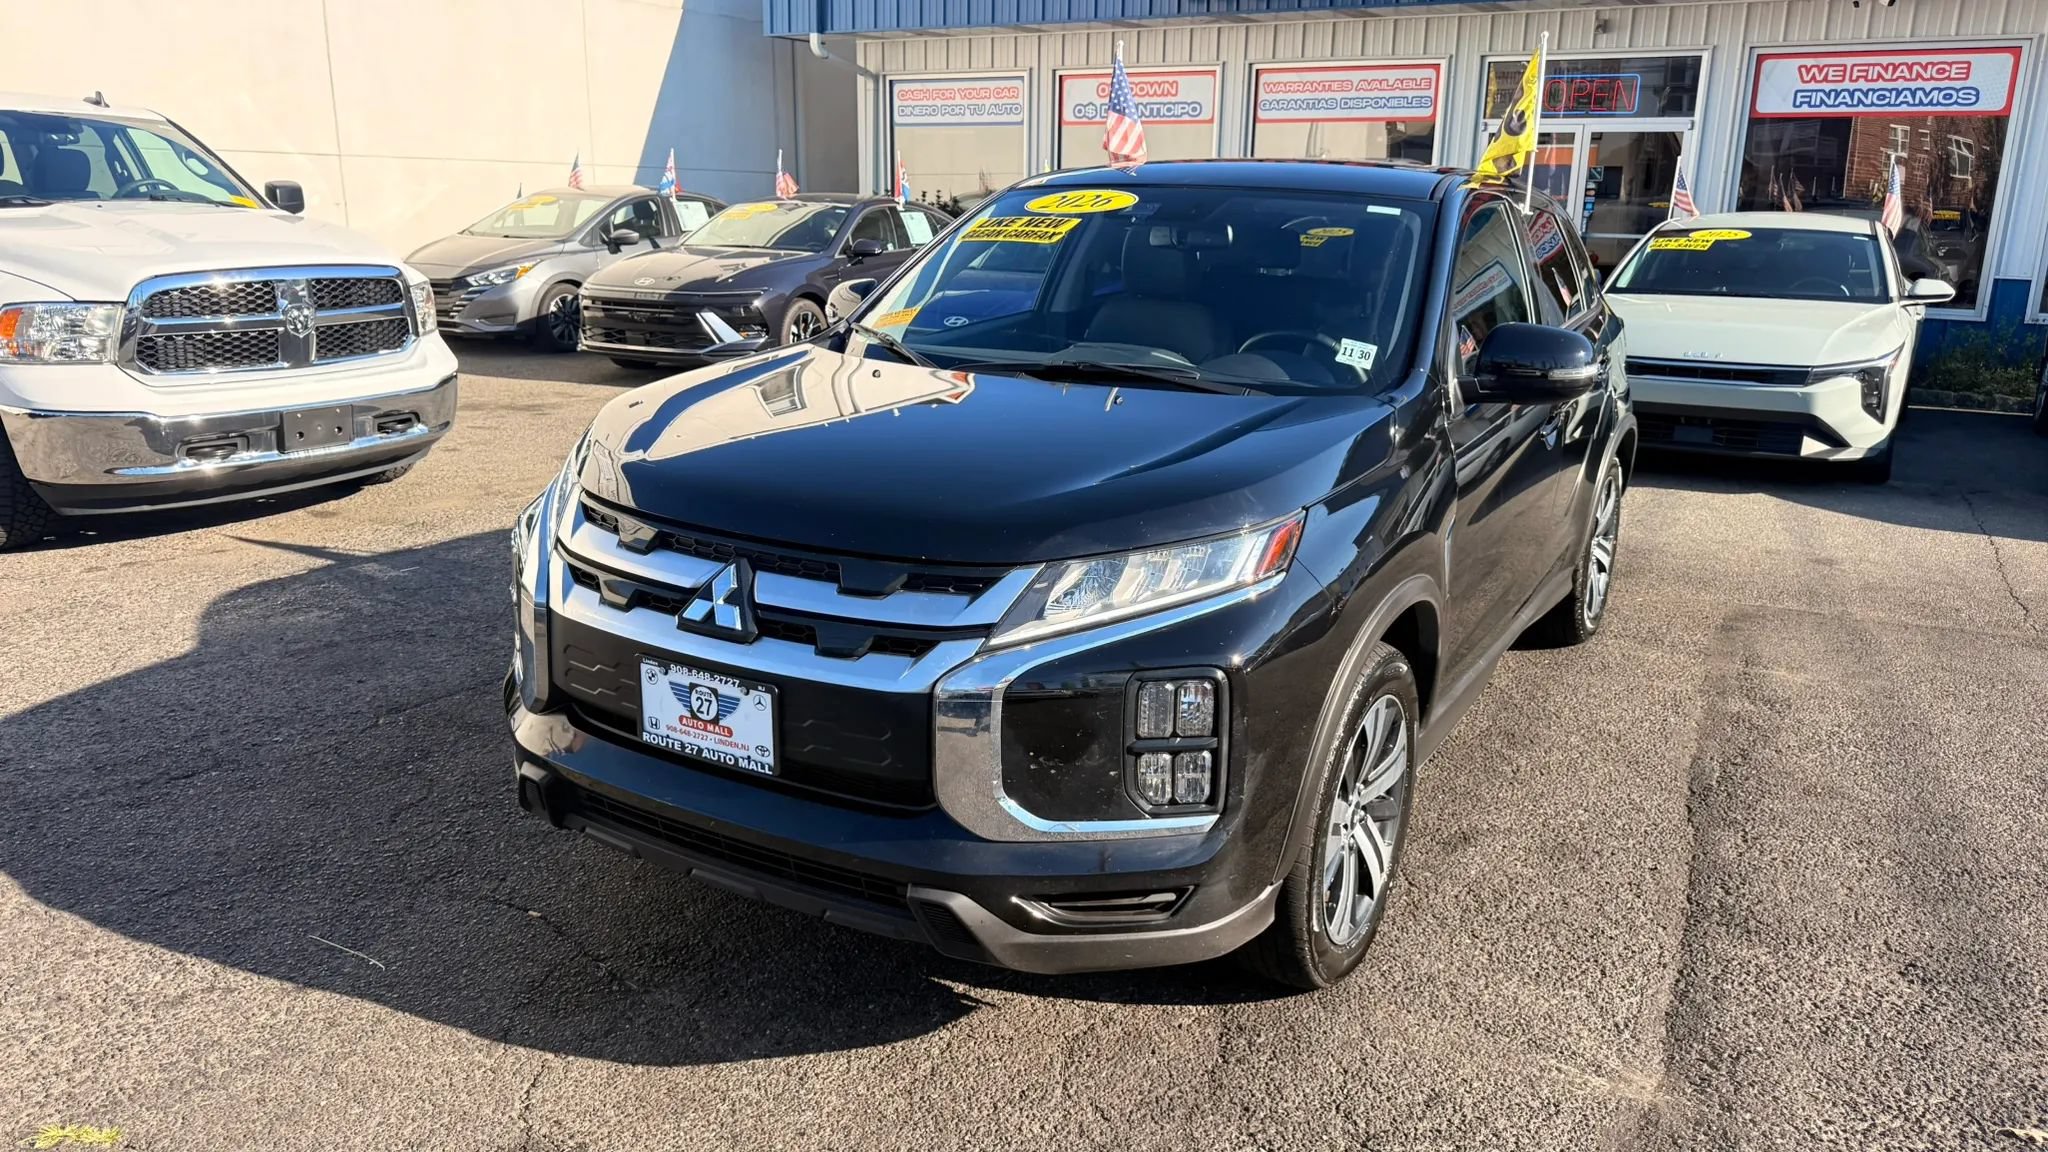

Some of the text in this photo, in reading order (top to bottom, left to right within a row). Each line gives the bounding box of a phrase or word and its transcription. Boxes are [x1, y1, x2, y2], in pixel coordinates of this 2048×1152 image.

[1798, 61, 1972, 84] WE FINANCE
[898, 86, 1019, 101] CASH FOR YOUR CAR
[1263, 78, 1432, 94] WARRANTIES AVAILABLE
[1259, 96, 1433, 111] GARANTIAS DISPONIBLES
[1543, 79, 1637, 112] OPEN
[1793, 86, 1980, 108] FINANCIAMOS
[898, 103, 1022, 117] DINERO POR TU AUTO
[1138, 101, 1202, 118] NTICIPO
[1038, 194, 1117, 210] 2026
[977, 217, 1072, 229] LIKE NEW
[962, 229, 1064, 240] CLEAN CARFAX
[1341, 347, 1354, 358] 11
[1357, 350, 1371, 361] 30
[670, 664, 740, 689] 908-648-2727
[695, 689, 713, 699] ROUTE
[695, 696, 713, 717] 27
[665, 724, 709, 741] 908-648-2727
[682, 717, 731, 737] AUTO MALL
[643, 732, 773, 775] ROUTE 27 AUTO MALL
